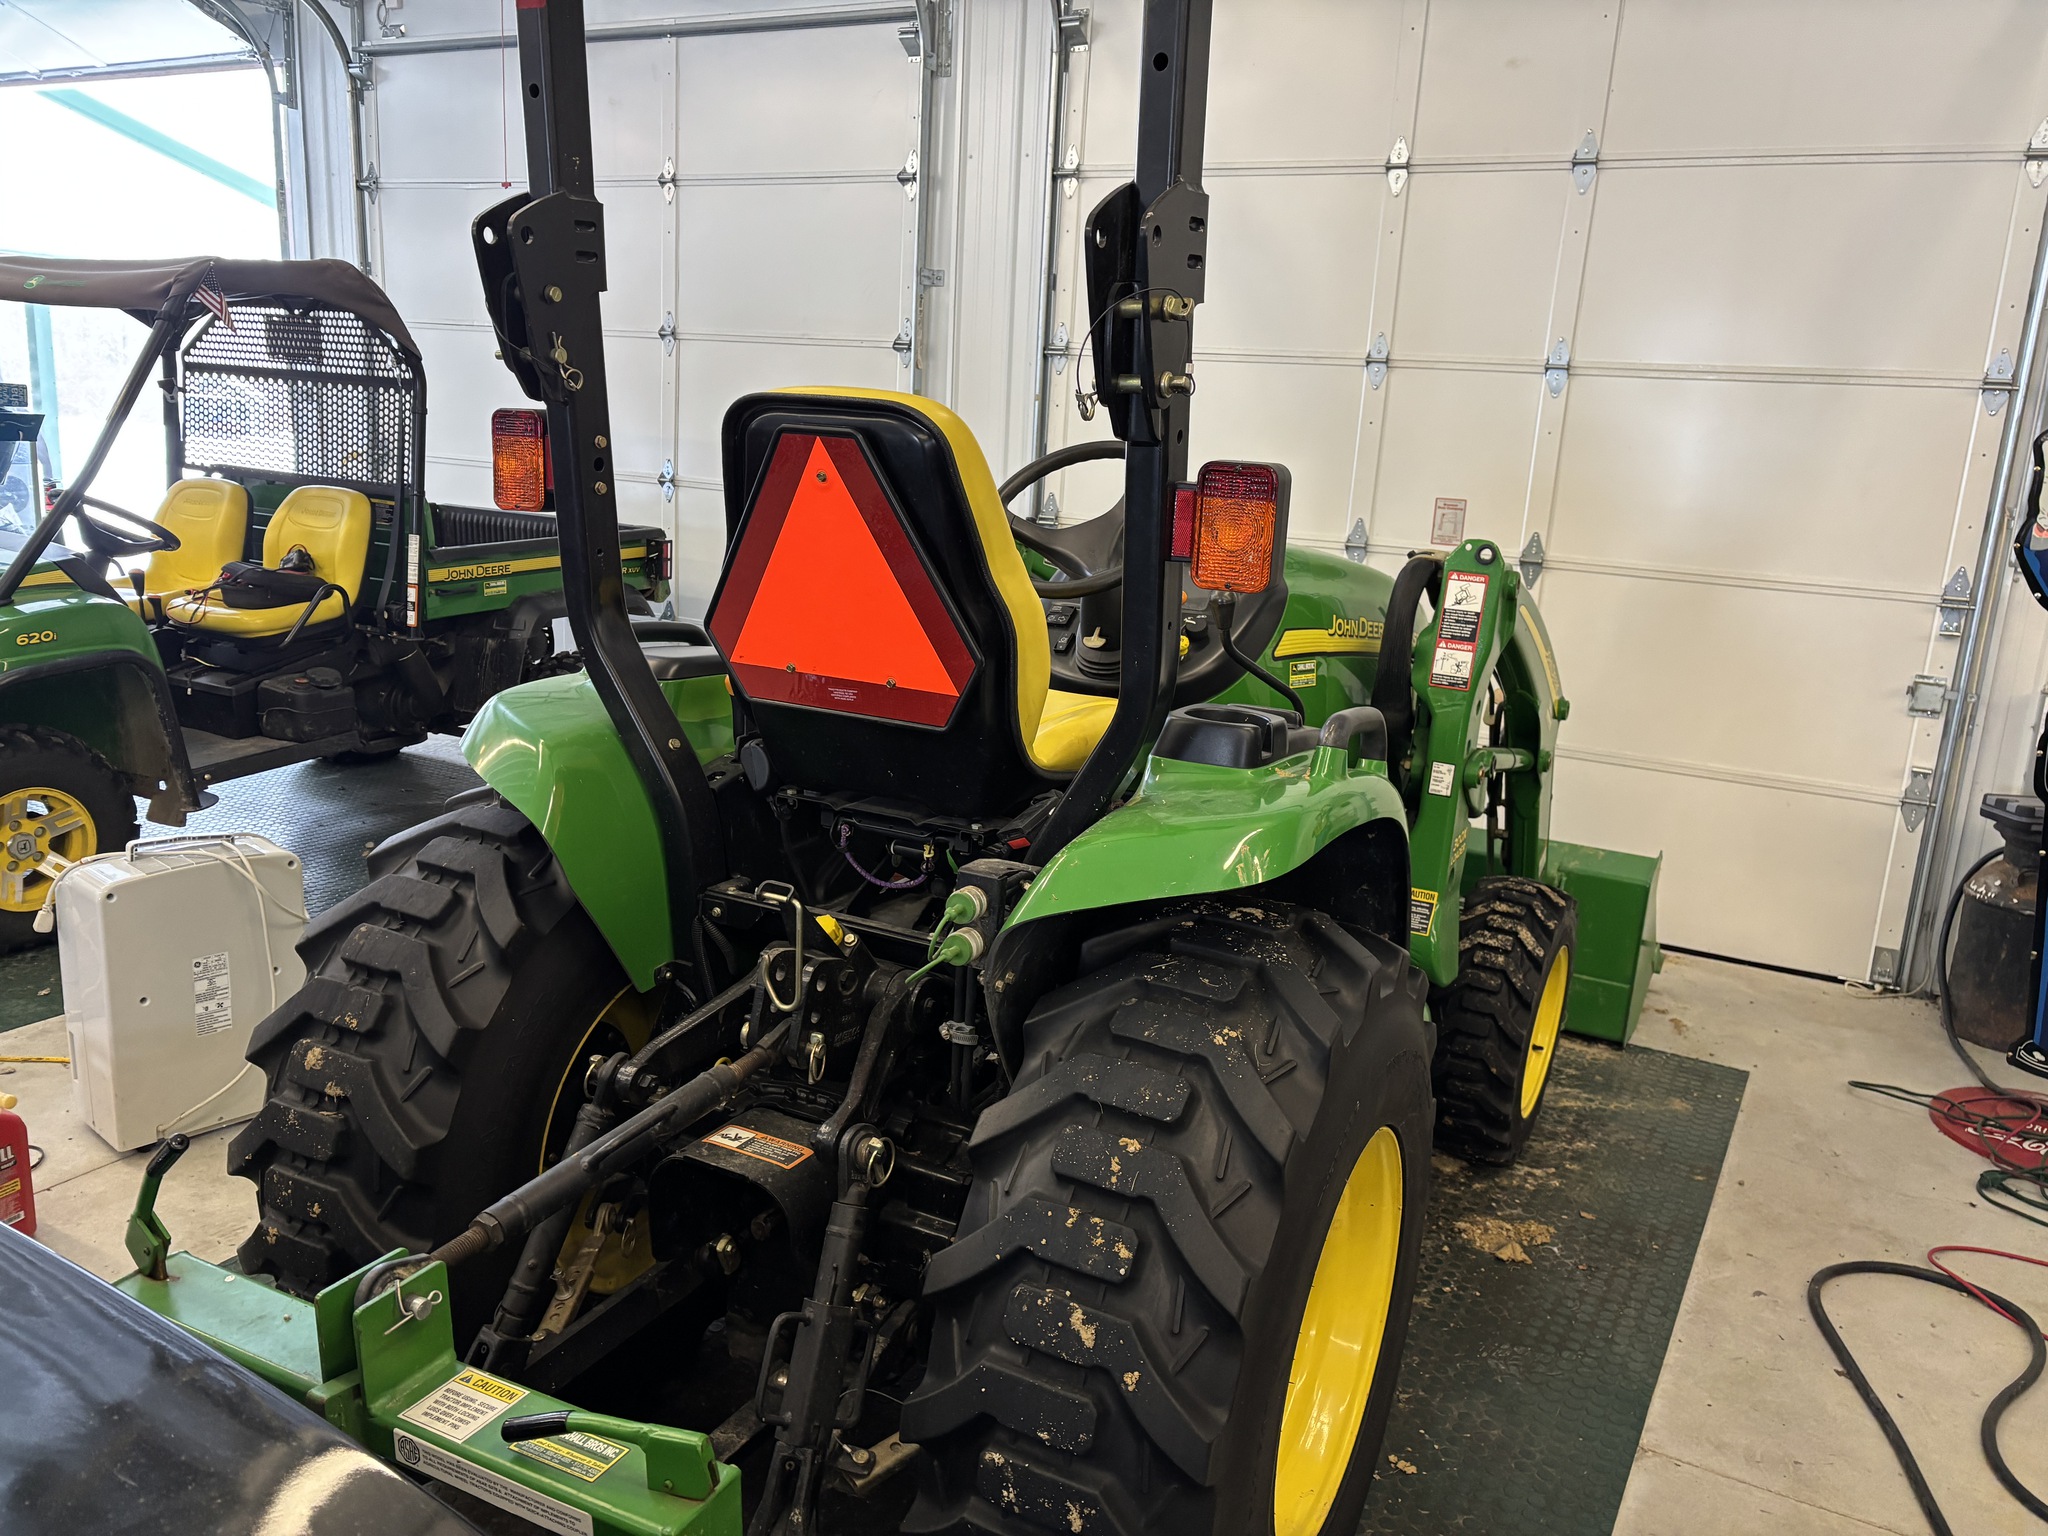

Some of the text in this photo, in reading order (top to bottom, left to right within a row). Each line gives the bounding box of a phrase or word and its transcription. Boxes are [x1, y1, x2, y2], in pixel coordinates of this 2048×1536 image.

[444, 564, 512, 580] JOHN DEERE
[1459, 574, 1485, 583] DANGER
[1328, 614, 1385, 639] JOHN DEER
[16, 630, 57, 646] 620i
[1447, 642, 1473, 651] DANGER
[1411, 890, 1436, 902] AUTION
[444, 1387, 463, 1400] BEFORE
[477, 1401, 498, 1412] SECURE
[472, 1379, 519, 1401] CAUTION
[426, 1404, 472, 1427] LUGS OVER LOWER
[433, 1399, 480, 1422] WITH BOTH LOCKING
[440, 1393, 488, 1417] TRACTOR IMPLEMENT
[421, 1410, 462, 1431] IMPLEMENT PINS
[584, 1437, 606, 1453] BROS
[602, 1445, 620, 1459] INC.
